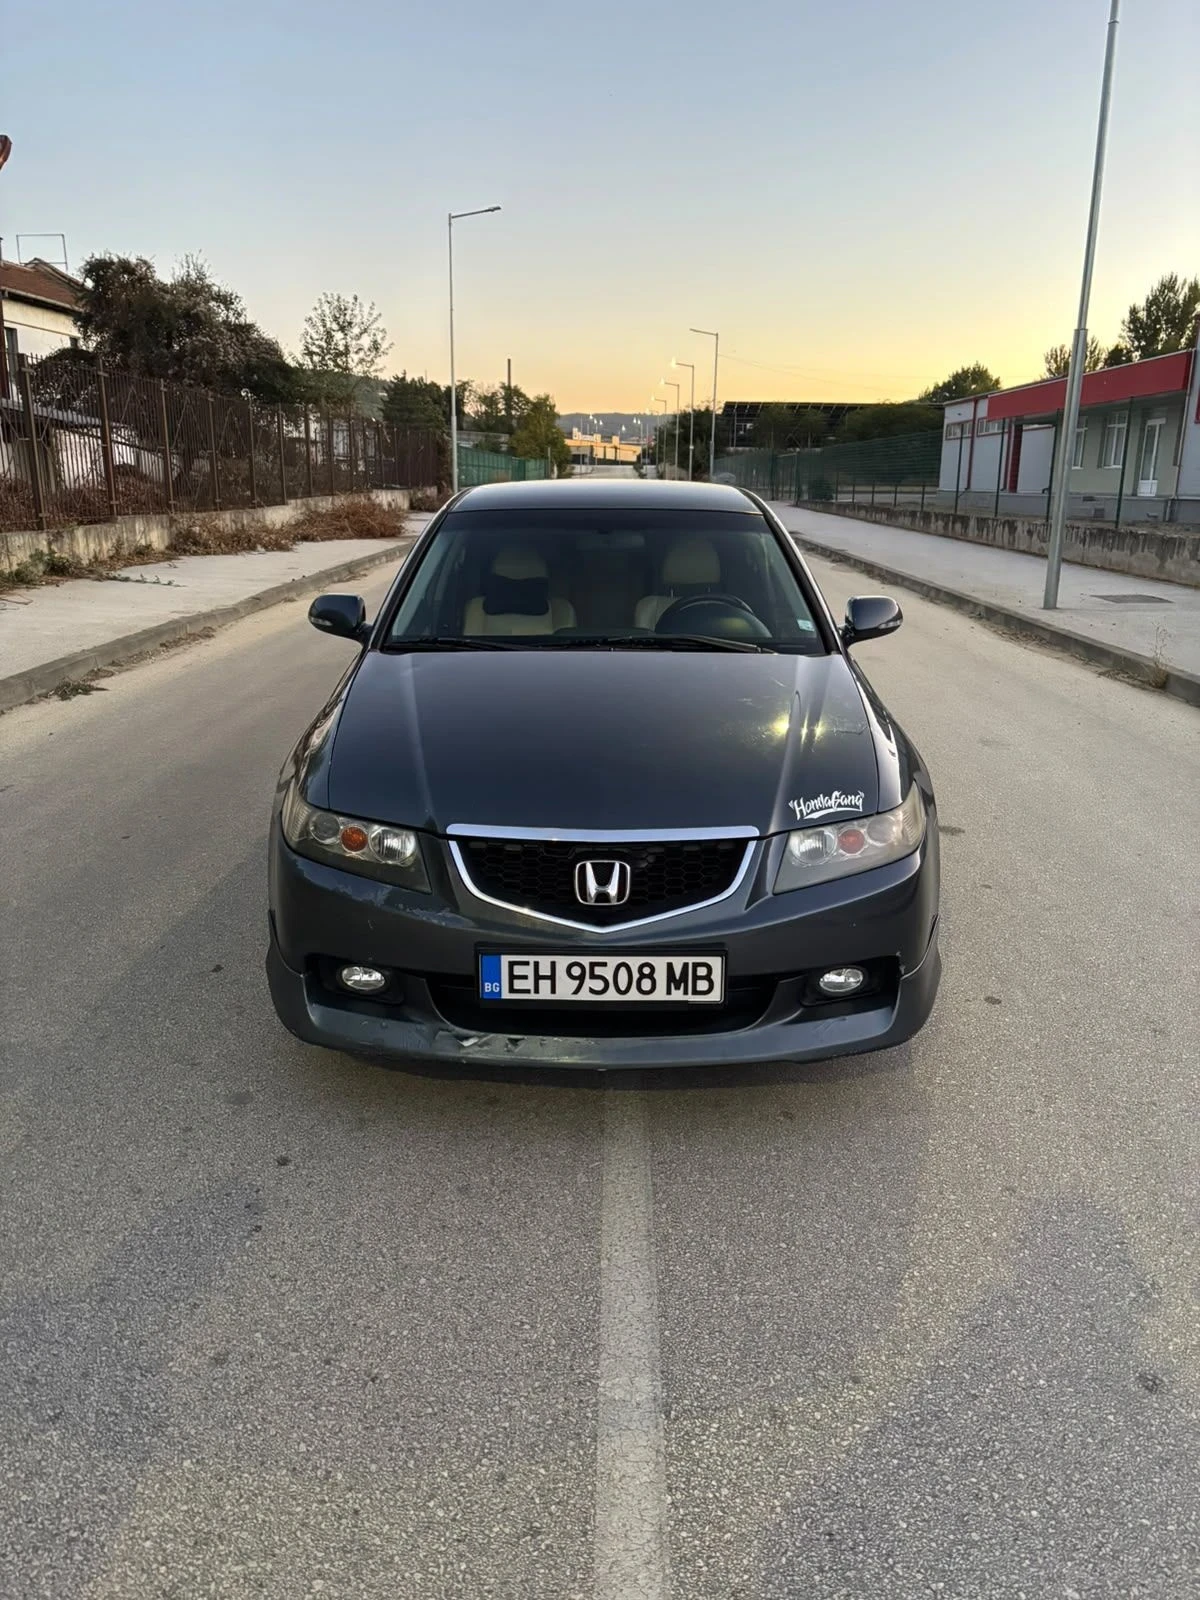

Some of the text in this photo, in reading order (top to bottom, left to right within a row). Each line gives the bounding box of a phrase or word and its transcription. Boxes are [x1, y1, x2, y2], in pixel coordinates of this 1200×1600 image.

[484, 982, 500, 993] BG
[507, 960, 714, 996] EH 9508 MB
